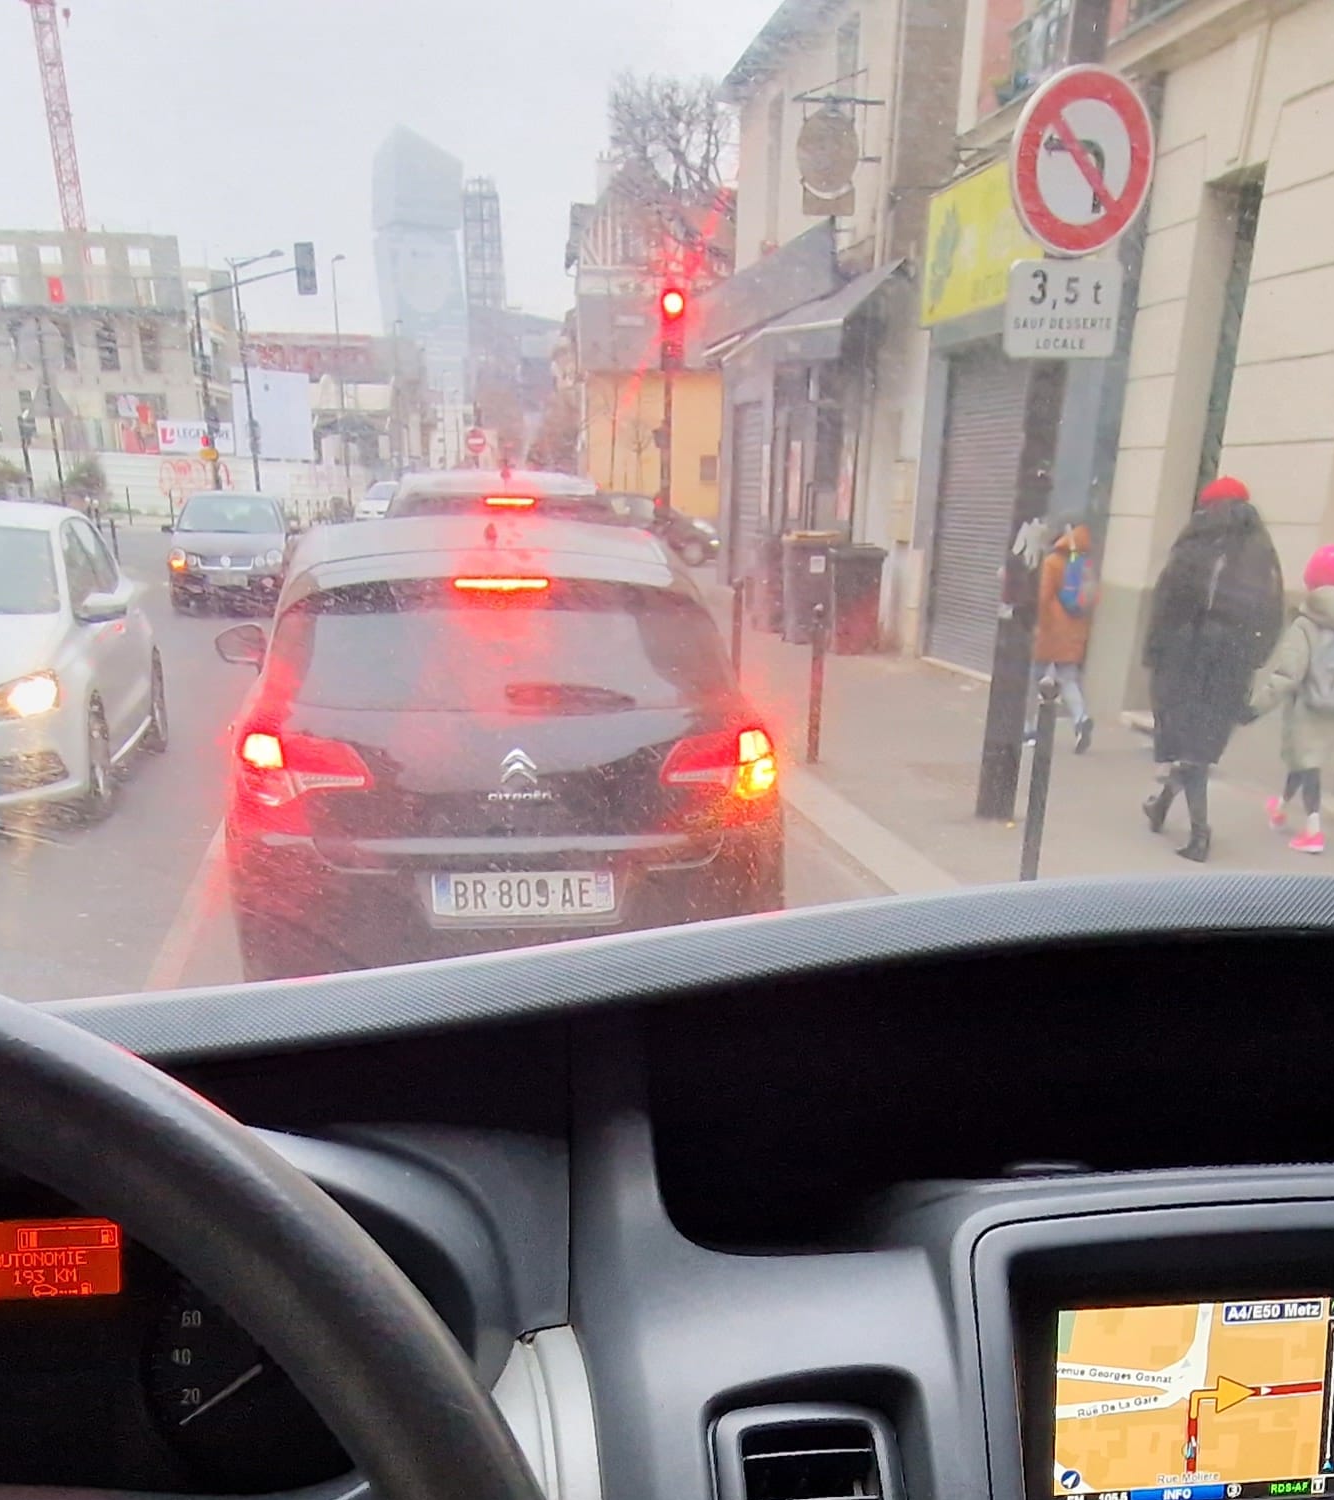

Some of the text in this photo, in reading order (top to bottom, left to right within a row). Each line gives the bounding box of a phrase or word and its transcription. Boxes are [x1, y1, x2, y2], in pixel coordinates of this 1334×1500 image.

[1029, 269, 1102, 310] 3,5 t
[1013, 318, 1112, 330] SAUF DESSERTE
[1035, 338, 1085, 350] LOCALE
[14, 1268, 78, 1285] 193 KM
[181, 1310, 202, 1327] 60
[1227, 1303, 1320, 1320] A4/E50 Metz
[173, 1348, 192, 1365] 40
[1089, 1368, 1131, 1381] Georges
[181, 1388, 201, 1405] 20
[1077, 1396, 1158, 1418] Rue De La Gare
[1158, 1475, 1178, 1484] Rue
[1270, 1481, 1309, 1493] RDS-AF
[1163, 1488, 1192, 1500] INFO
